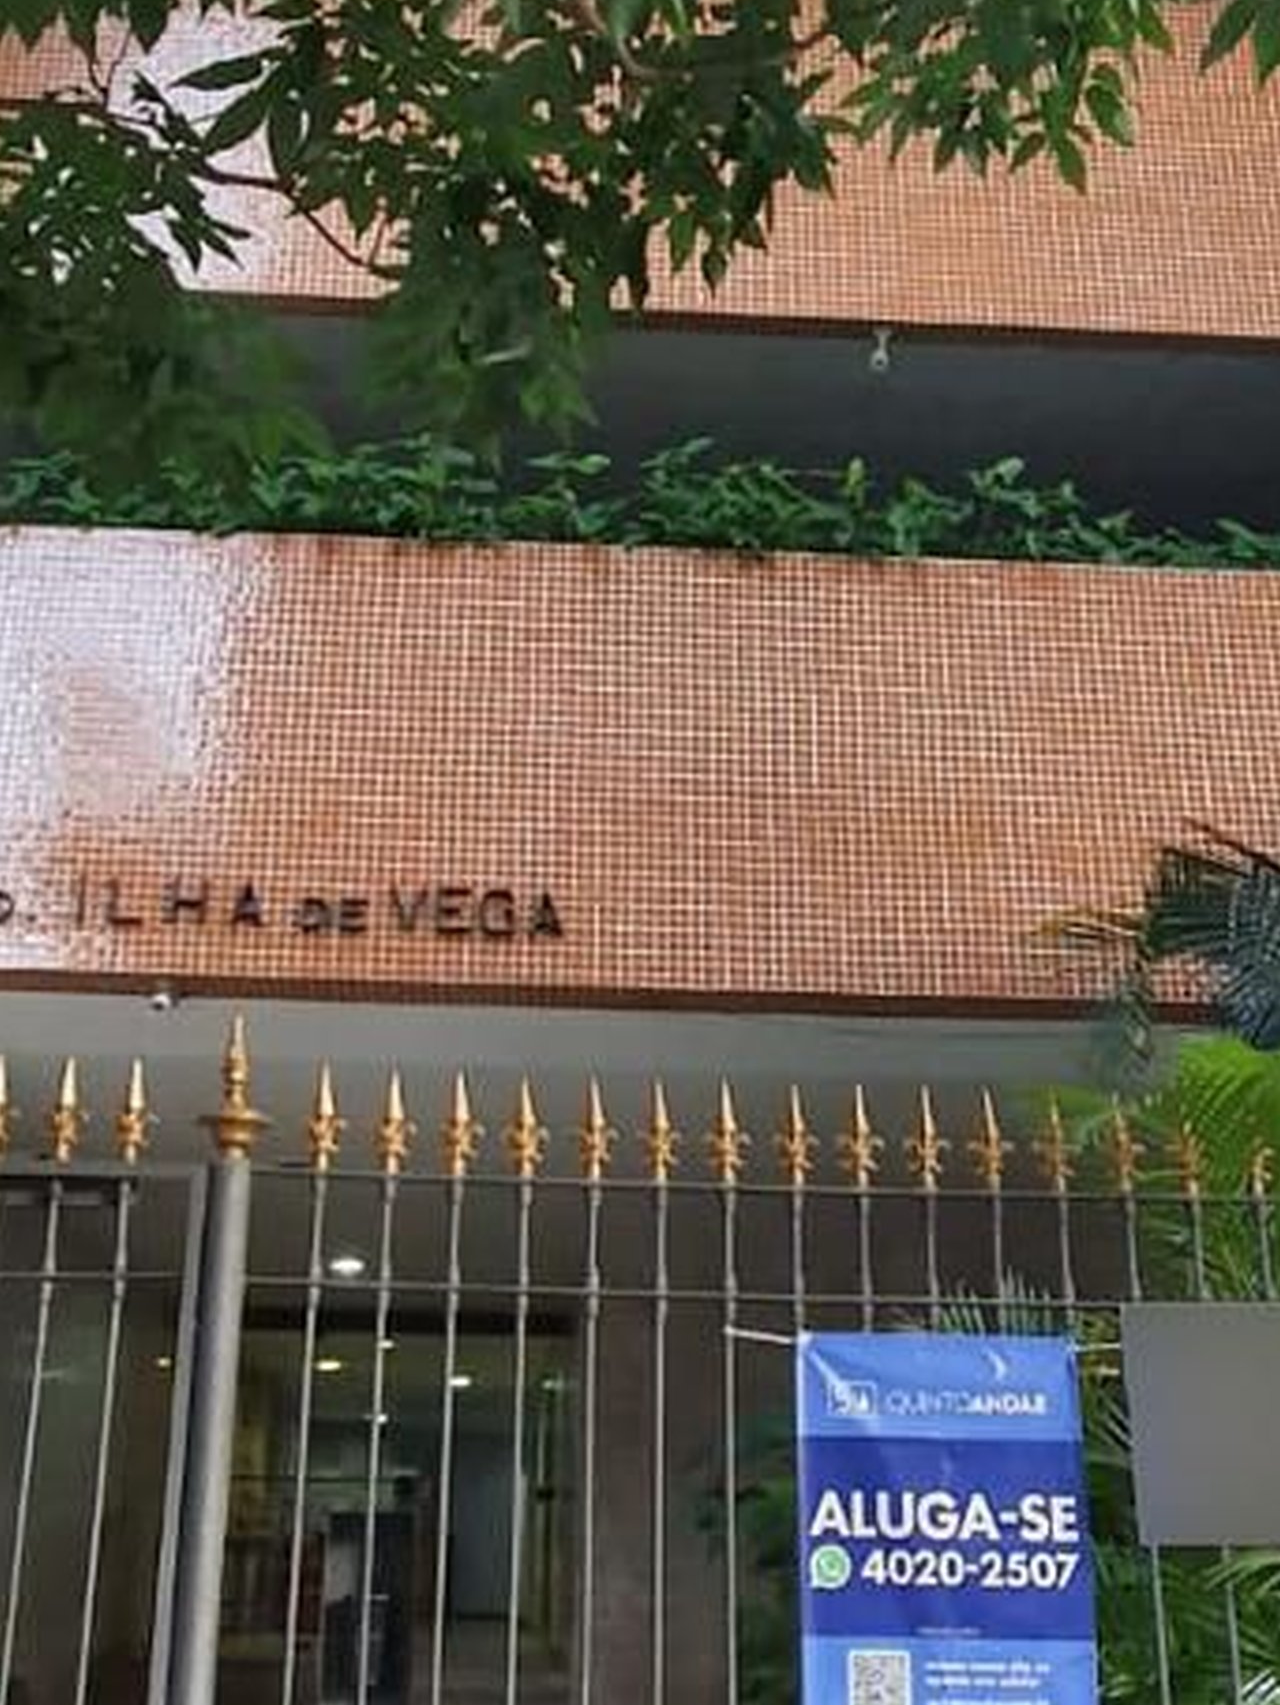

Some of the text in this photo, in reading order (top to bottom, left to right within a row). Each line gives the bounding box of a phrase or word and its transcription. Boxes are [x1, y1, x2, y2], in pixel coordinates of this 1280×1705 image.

[74, 876, 266, 927] ILHA
[390, 887, 565, 937] VEGA
[811, 1490, 1080, 1543] ALUGA-SE
[861, 1551, 1081, 1589] 4020-2507
